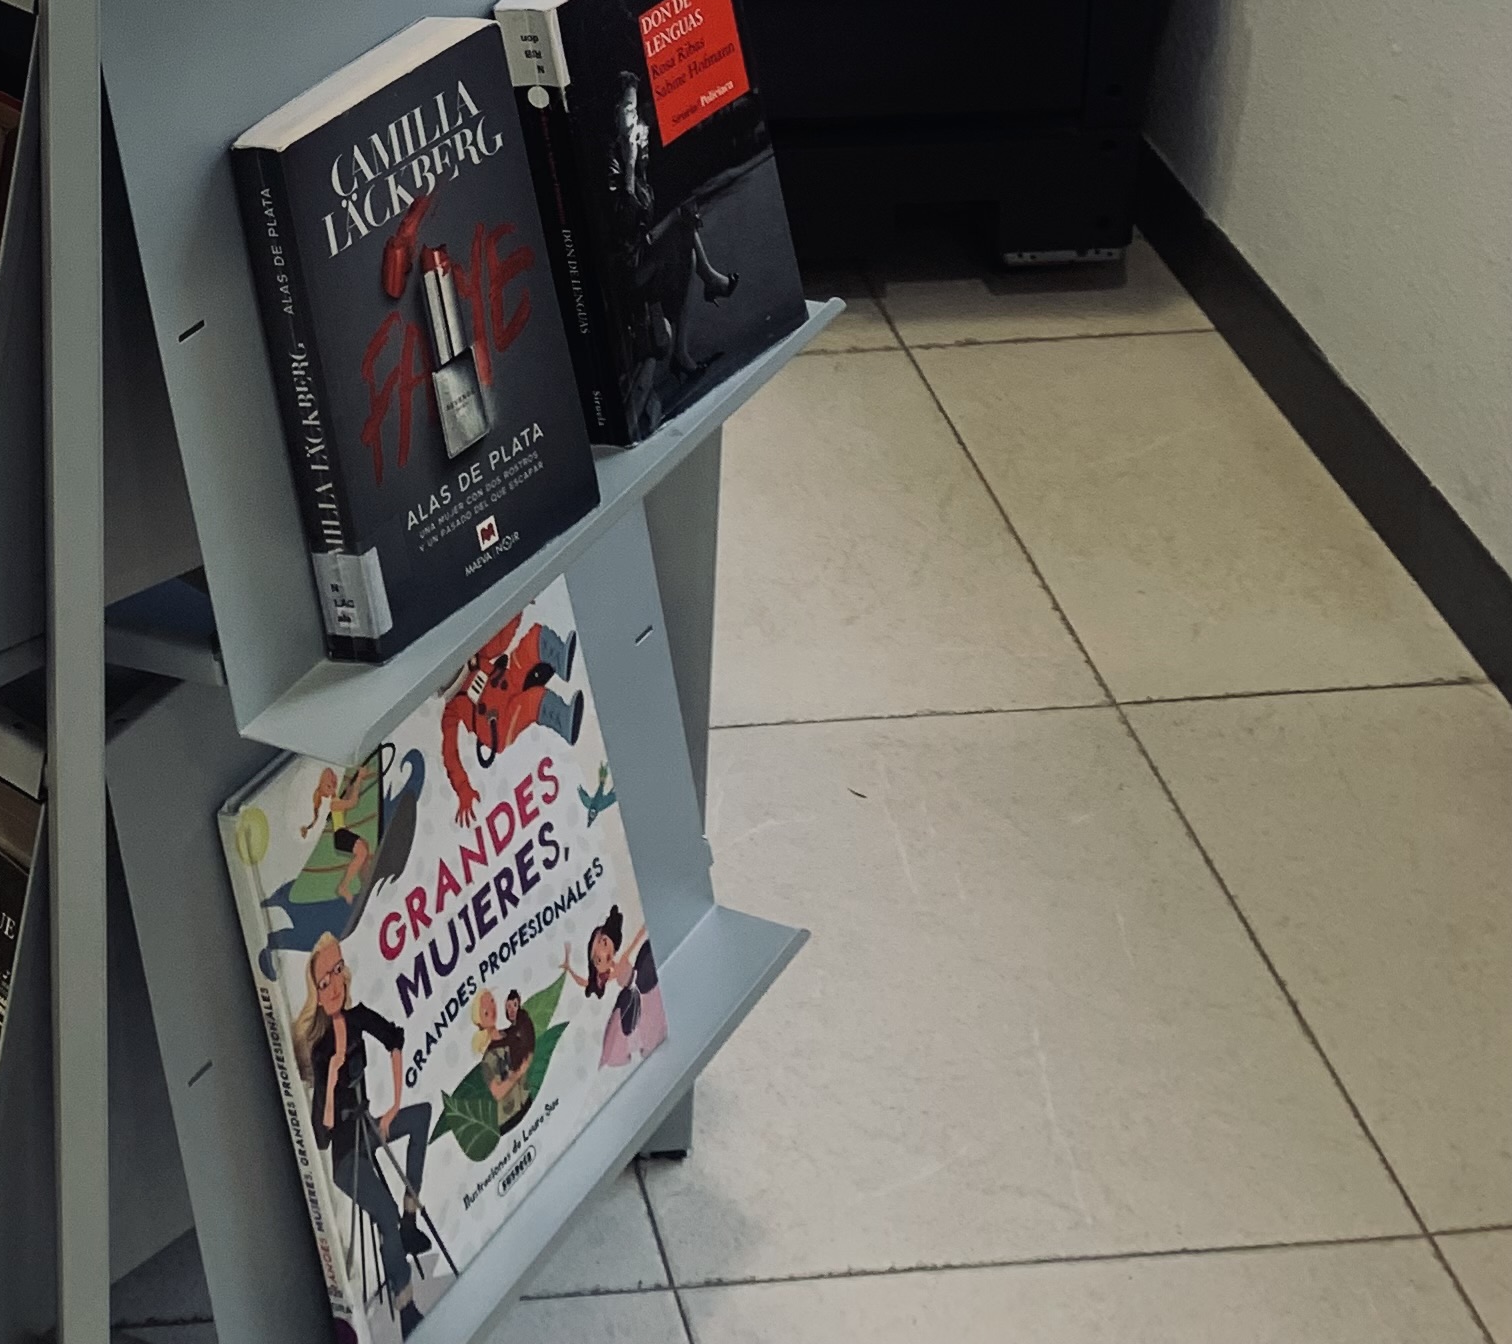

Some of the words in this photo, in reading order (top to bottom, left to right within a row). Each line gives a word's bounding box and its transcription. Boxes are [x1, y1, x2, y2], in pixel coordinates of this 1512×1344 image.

[641, 2, 672, 35] DON
[645, 8, 704, 58] LENGUAS
[650, 58, 676, 80] Rosa
[676, 37, 705, 63] Ribas
[655, 73, 686, 98] Sabine
[331, 80, 483, 197] CAMILLA
[260, 188, 279, 238] PLATA
[322, 115, 504, 259] LÄCKBERG
[271, 245, 285, 267] DE
[562, 229, 576, 258] DON
[567, 260, 579, 275] DE
[277, 273, 295, 315] ALAS
[571, 279, 591, 334] LENGUAS
[408, 484, 452, 531] ALAS
[458, 462, 483, 492] DE
[488, 422, 544, 471] PLATA
[419, 522, 436, 539] UNA
[438, 502, 465, 524] MUJER
[466, 488, 484, 505] CON
[485, 475, 502, 492] DOS
[503, 450, 539, 480] ROSTROS
[427, 536, 439, 548] UN
[440, 510, 472, 538] PASADO
[473, 500, 489, 515] DEL
[490, 486, 507, 503] QUE
[508, 461, 544, 491] ESCAPAR
[465, 552, 493, 577] MAEVA
[378, 756, 559, 961] GRANDES
[395, 821, 570, 1018] MUJERES,
[404, 975, 478, 1089] GRANDES
[478, 856, 604, 984] PROFESIONALES
[259, 987, 293, 1099] PROFESIONALES
[285, 1099, 310, 1168] GRANDES
[463, 1153, 511, 1211] Ilustraciones
[512, 1139, 522, 1154] de
